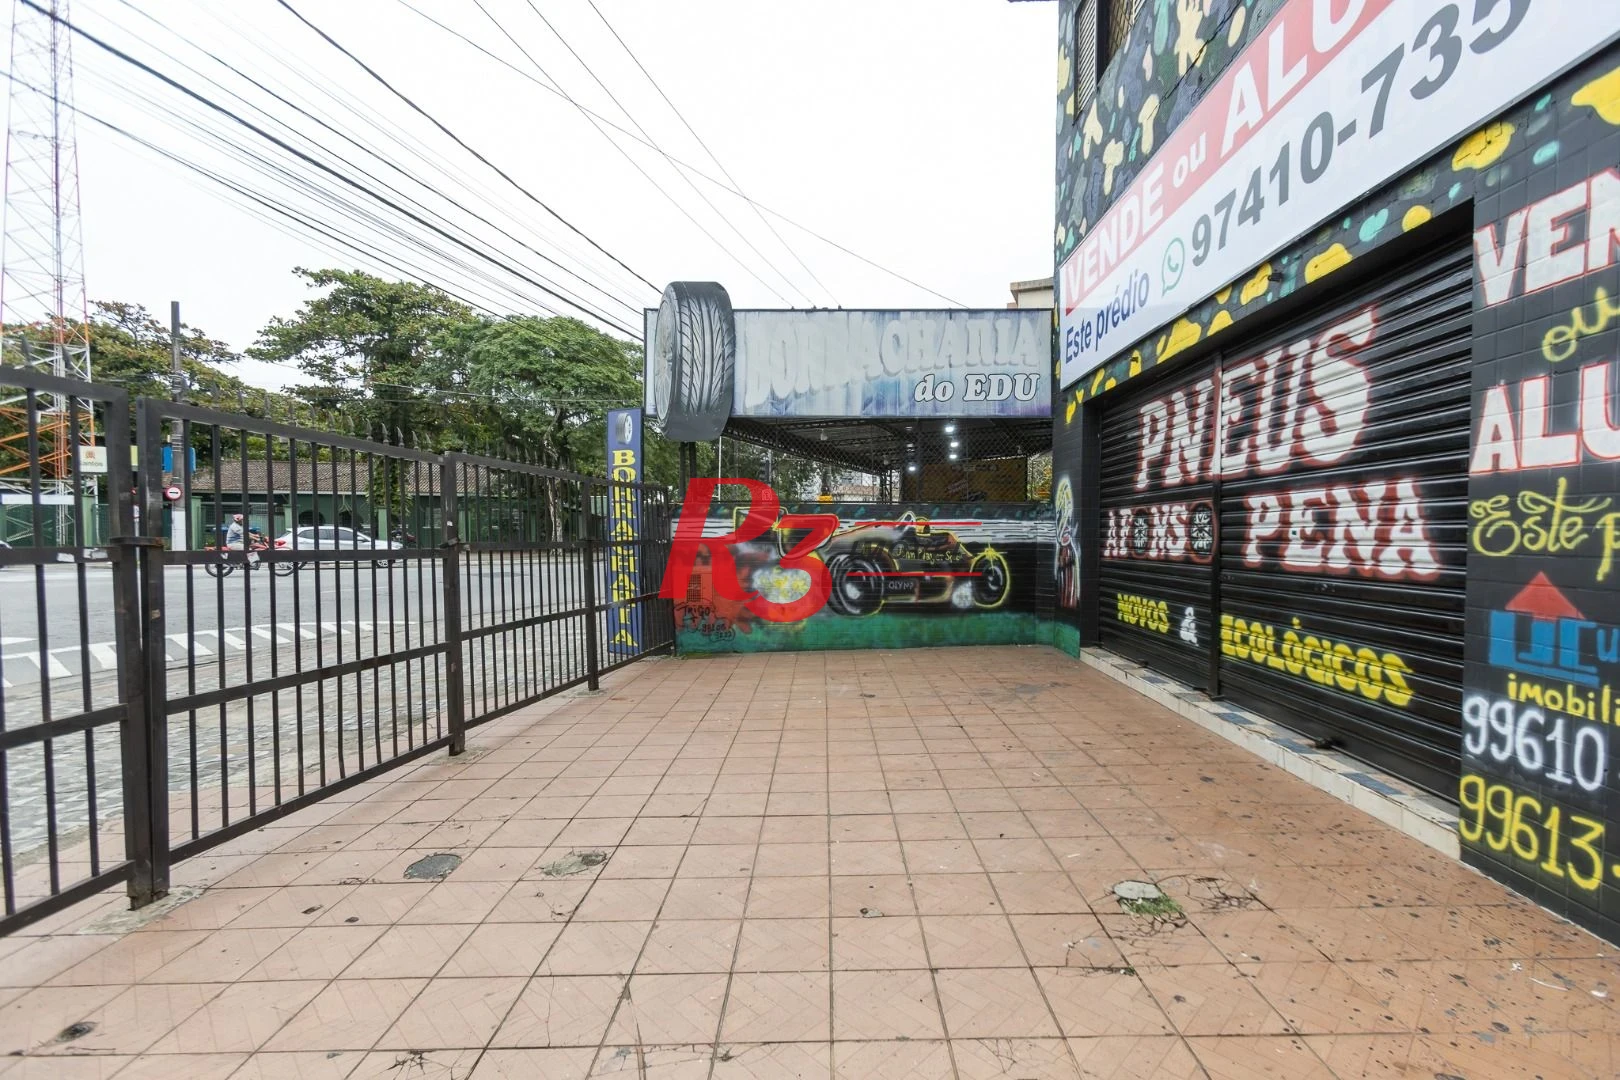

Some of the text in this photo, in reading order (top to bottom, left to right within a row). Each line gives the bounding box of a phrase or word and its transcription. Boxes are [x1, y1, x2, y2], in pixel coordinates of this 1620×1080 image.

[1065, 160, 1165, 302] VENDE
[1172, 132, 1207, 189] ou
[1066, 318, 1093, 364] Este
[1095, 269, 1150, 352] prédio
[914, 373, 1041, 402] do EDU
[1134, 304, 1378, 492] PNEUS
[1242, 476, 1442, 582] PENA
[1470, 477, 1612, 557] Este
